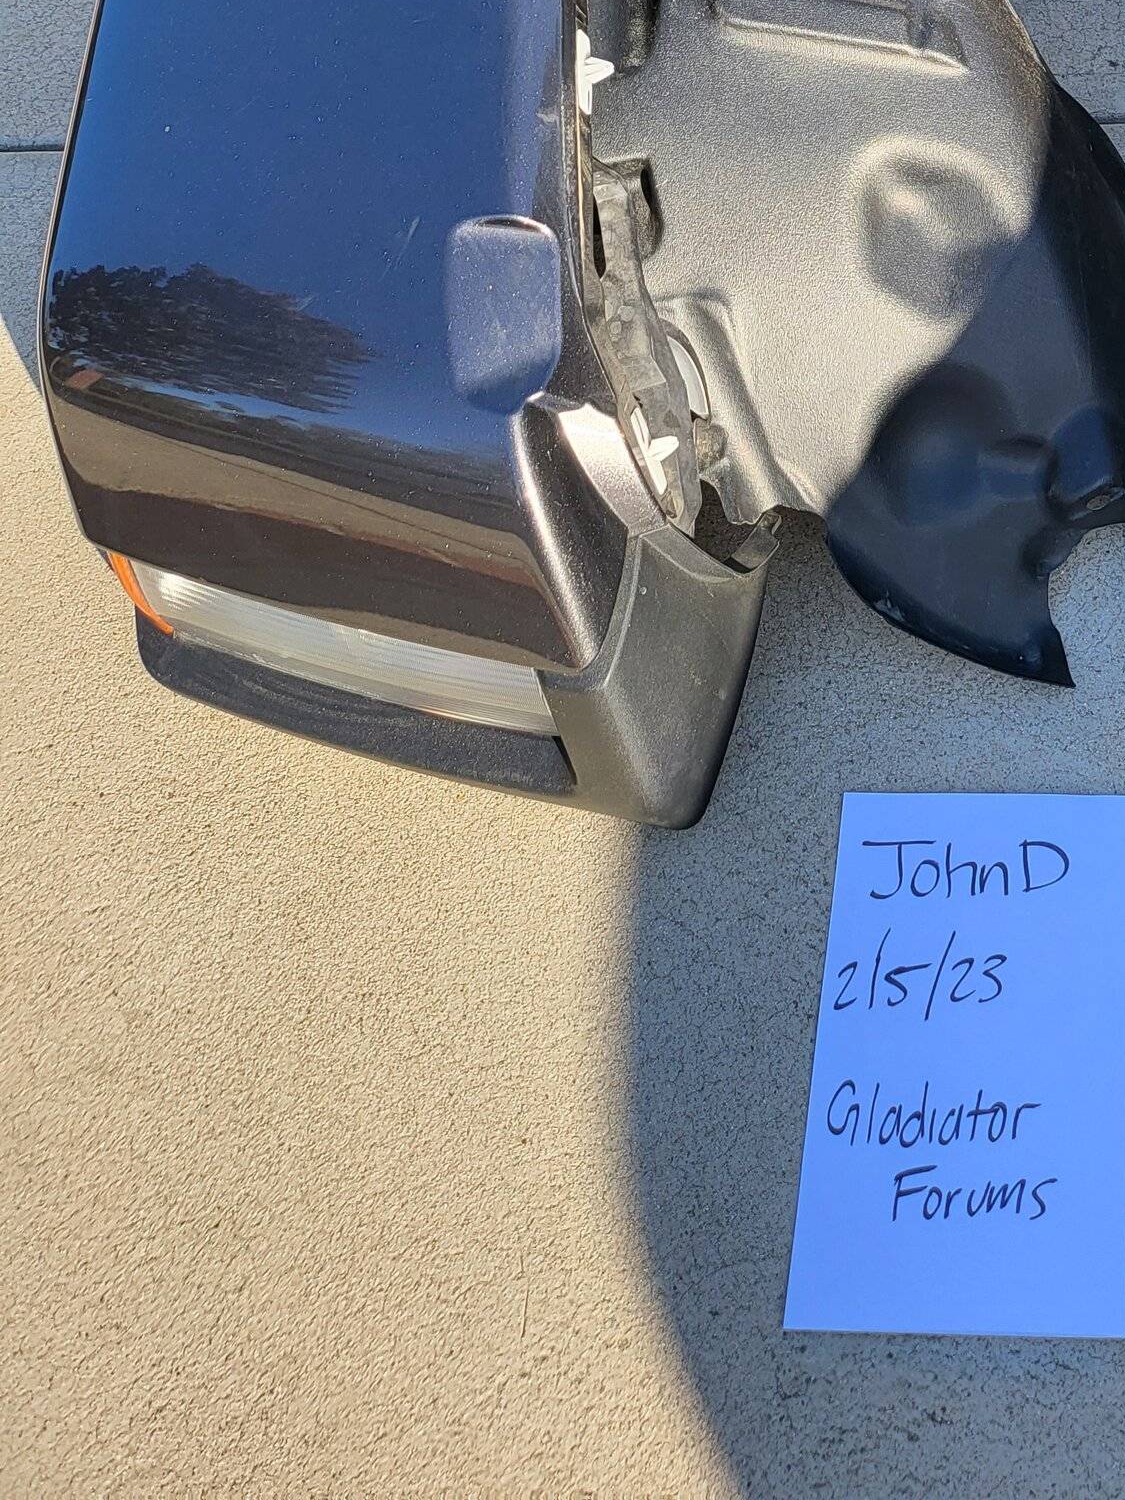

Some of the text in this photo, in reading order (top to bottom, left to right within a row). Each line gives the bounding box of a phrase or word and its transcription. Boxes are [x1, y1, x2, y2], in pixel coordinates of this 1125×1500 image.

[833, 927, 1008, 1022] 2/5/23
[826, 1079, 1042, 1149] Gladiator
[891, 1164, 1059, 1222] Forums
